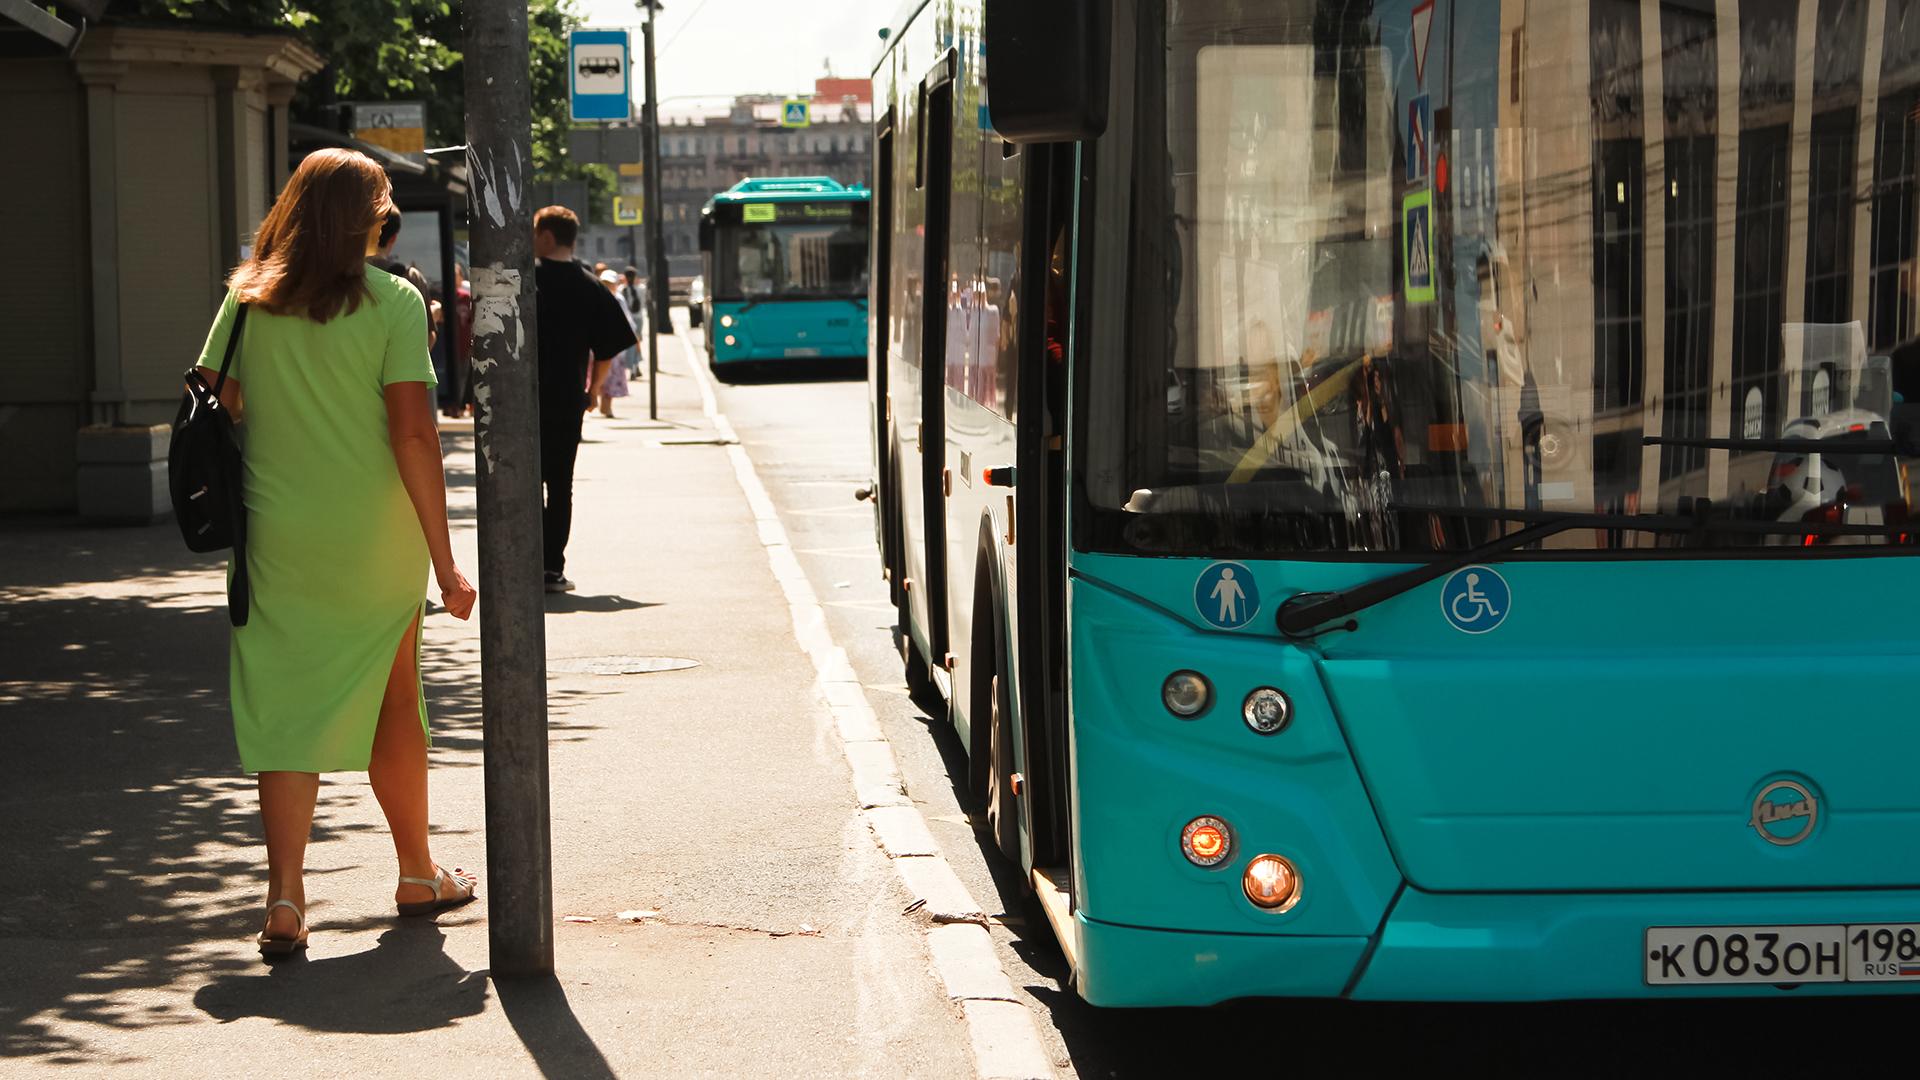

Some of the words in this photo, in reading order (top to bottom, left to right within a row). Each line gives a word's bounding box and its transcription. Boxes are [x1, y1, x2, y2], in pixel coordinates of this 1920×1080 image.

[1661, 932, 1840, 978] К083ОН
[1851, 928, 1916, 962] 198
[1864, 963, 1897, 976] RUS
